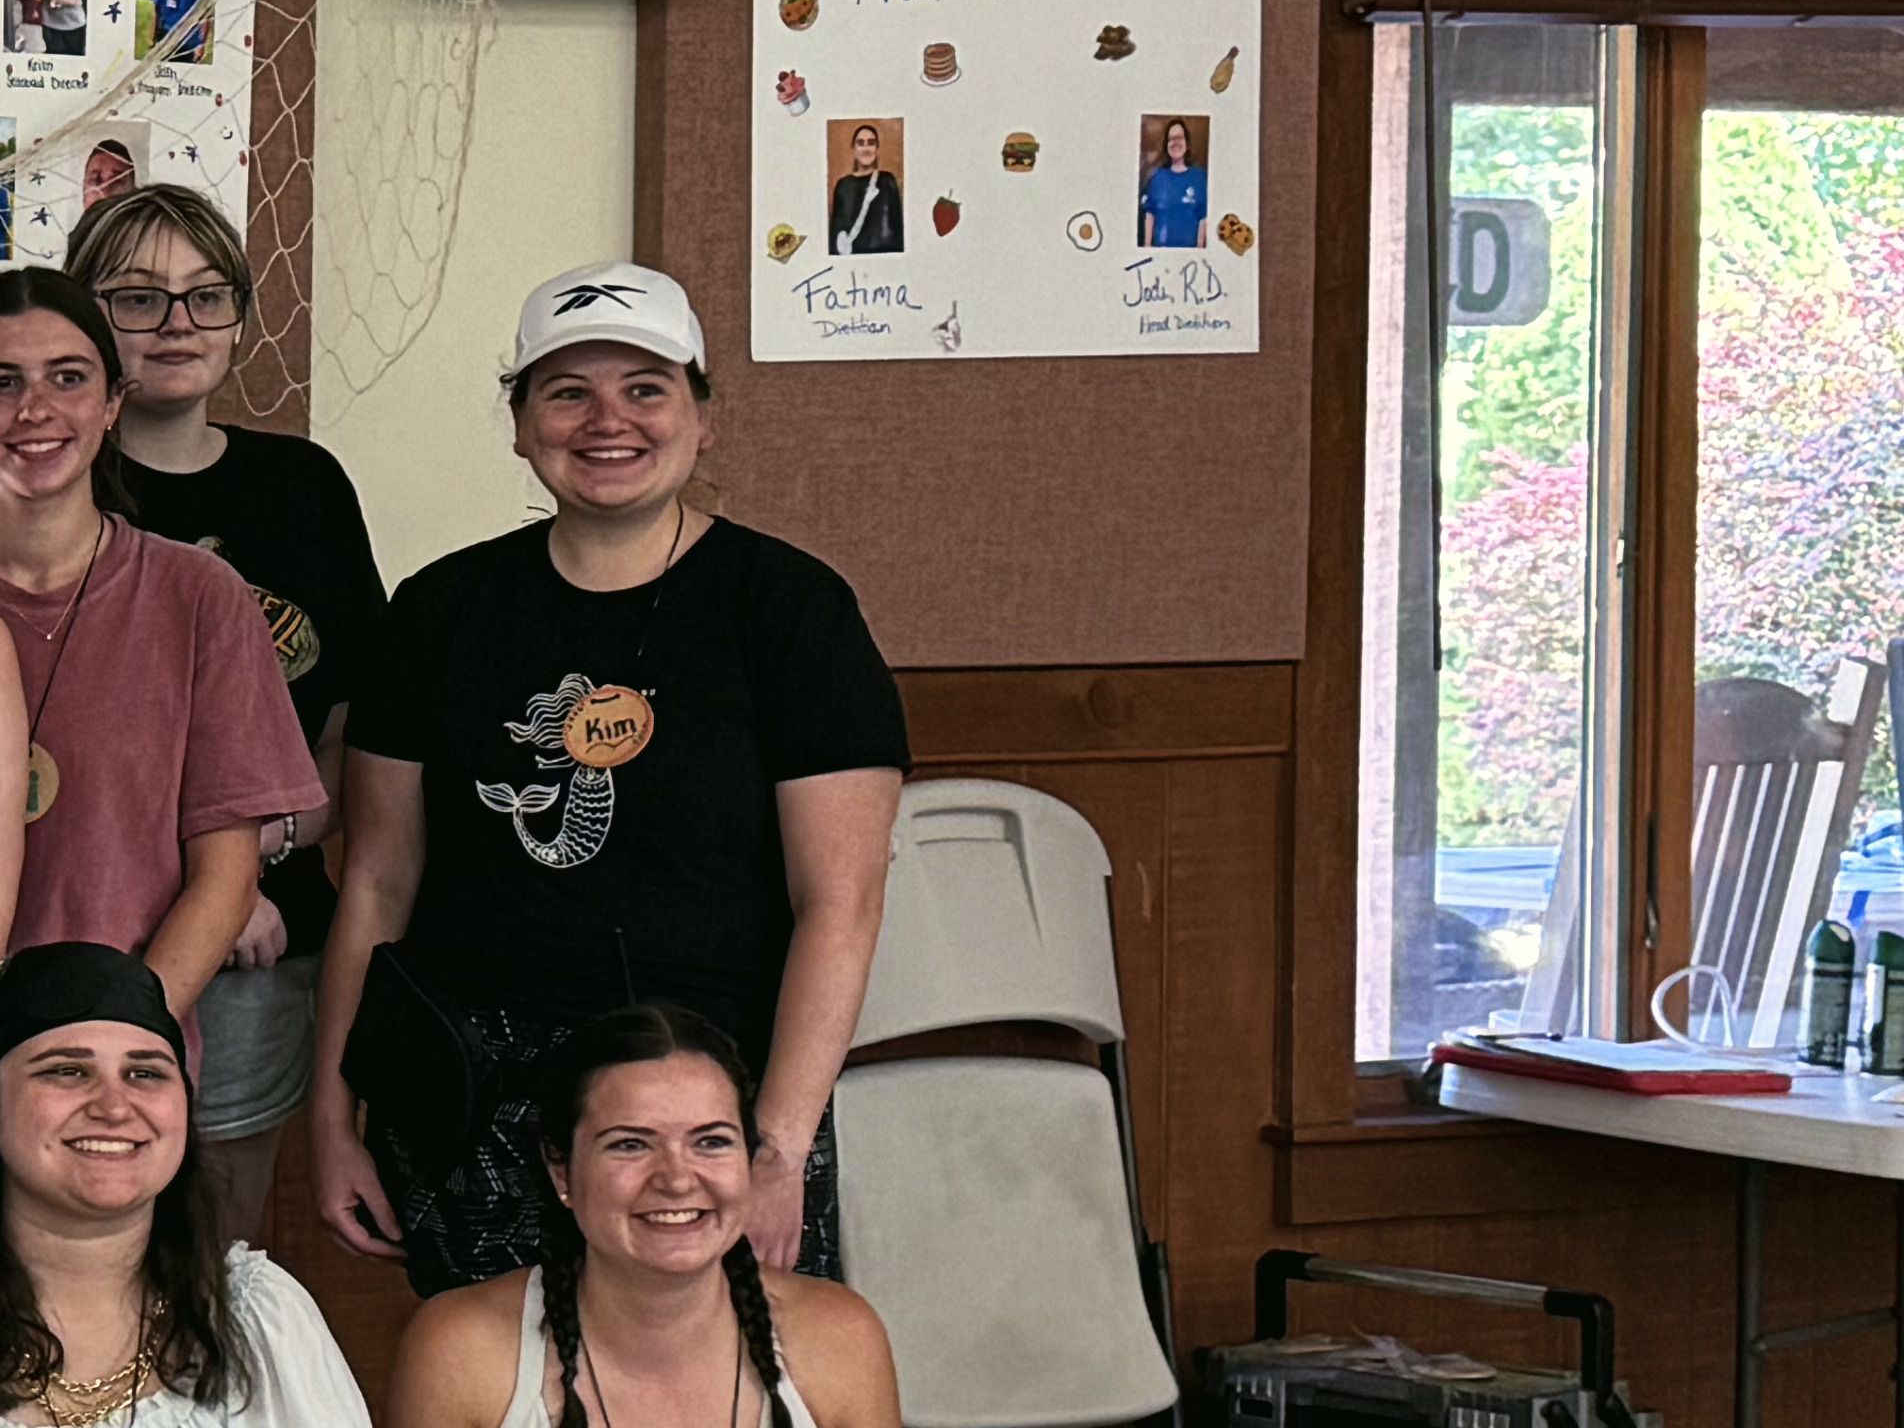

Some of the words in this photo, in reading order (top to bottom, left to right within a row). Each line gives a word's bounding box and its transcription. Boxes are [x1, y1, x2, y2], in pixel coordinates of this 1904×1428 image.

[791, 265, 924, 314] Fatima
[1179, 257, 1229, 306] R.D.
[585, 716, 638, 744] Kim
